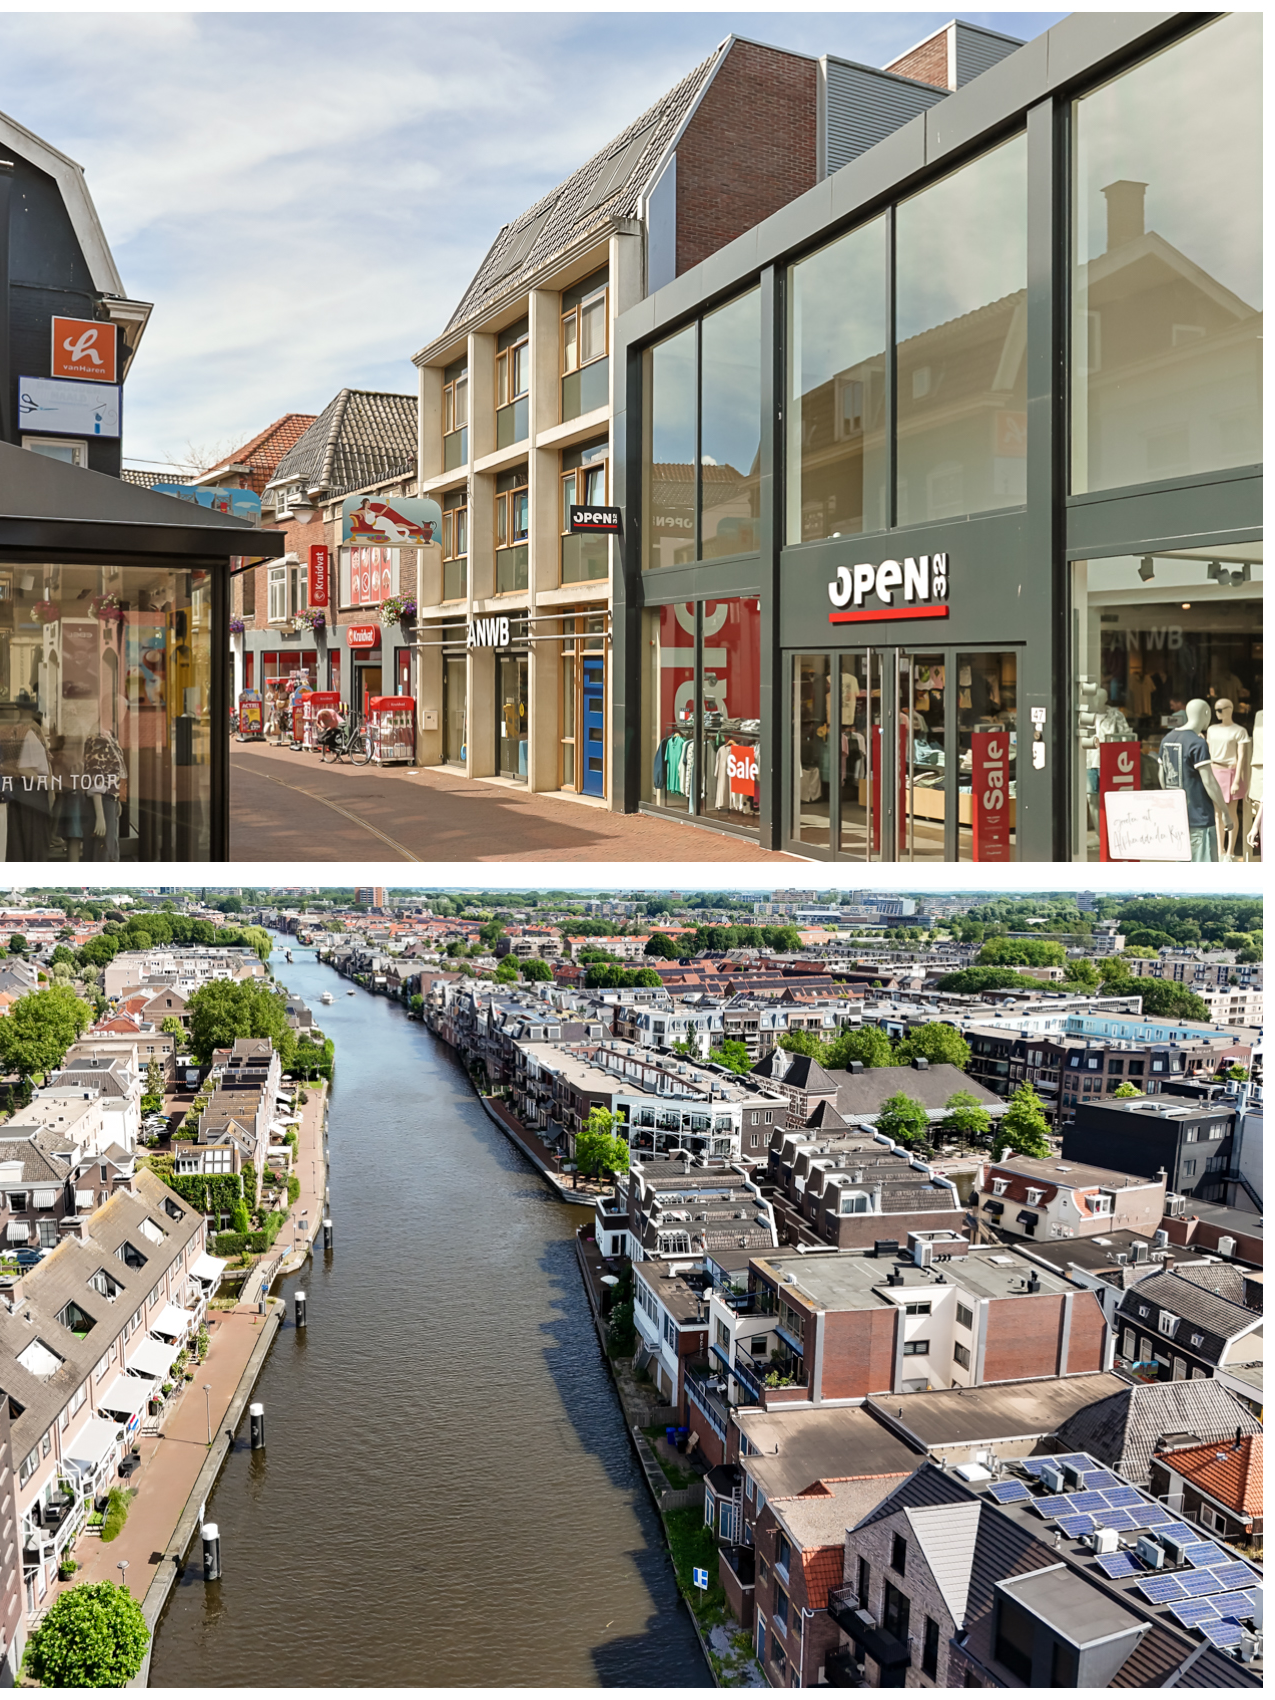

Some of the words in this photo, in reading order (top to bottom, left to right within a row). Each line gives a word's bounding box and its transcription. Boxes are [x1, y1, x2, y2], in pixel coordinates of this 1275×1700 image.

[62, 364, 106, 374] vanHaren
[315, 551, 324, 590] Kruidvat
[932, 552, 947, 598] 32
[353, 628, 373, 642] Kruidvat
[467, 616, 510, 647] ANWB
[1033, 709, 1044, 720] 47
[726, 754, 759, 781] Sale
[983, 740, 1004, 810] Sale
[21, 774, 63, 792] VAN
[70, 773, 120, 791] TOOR
